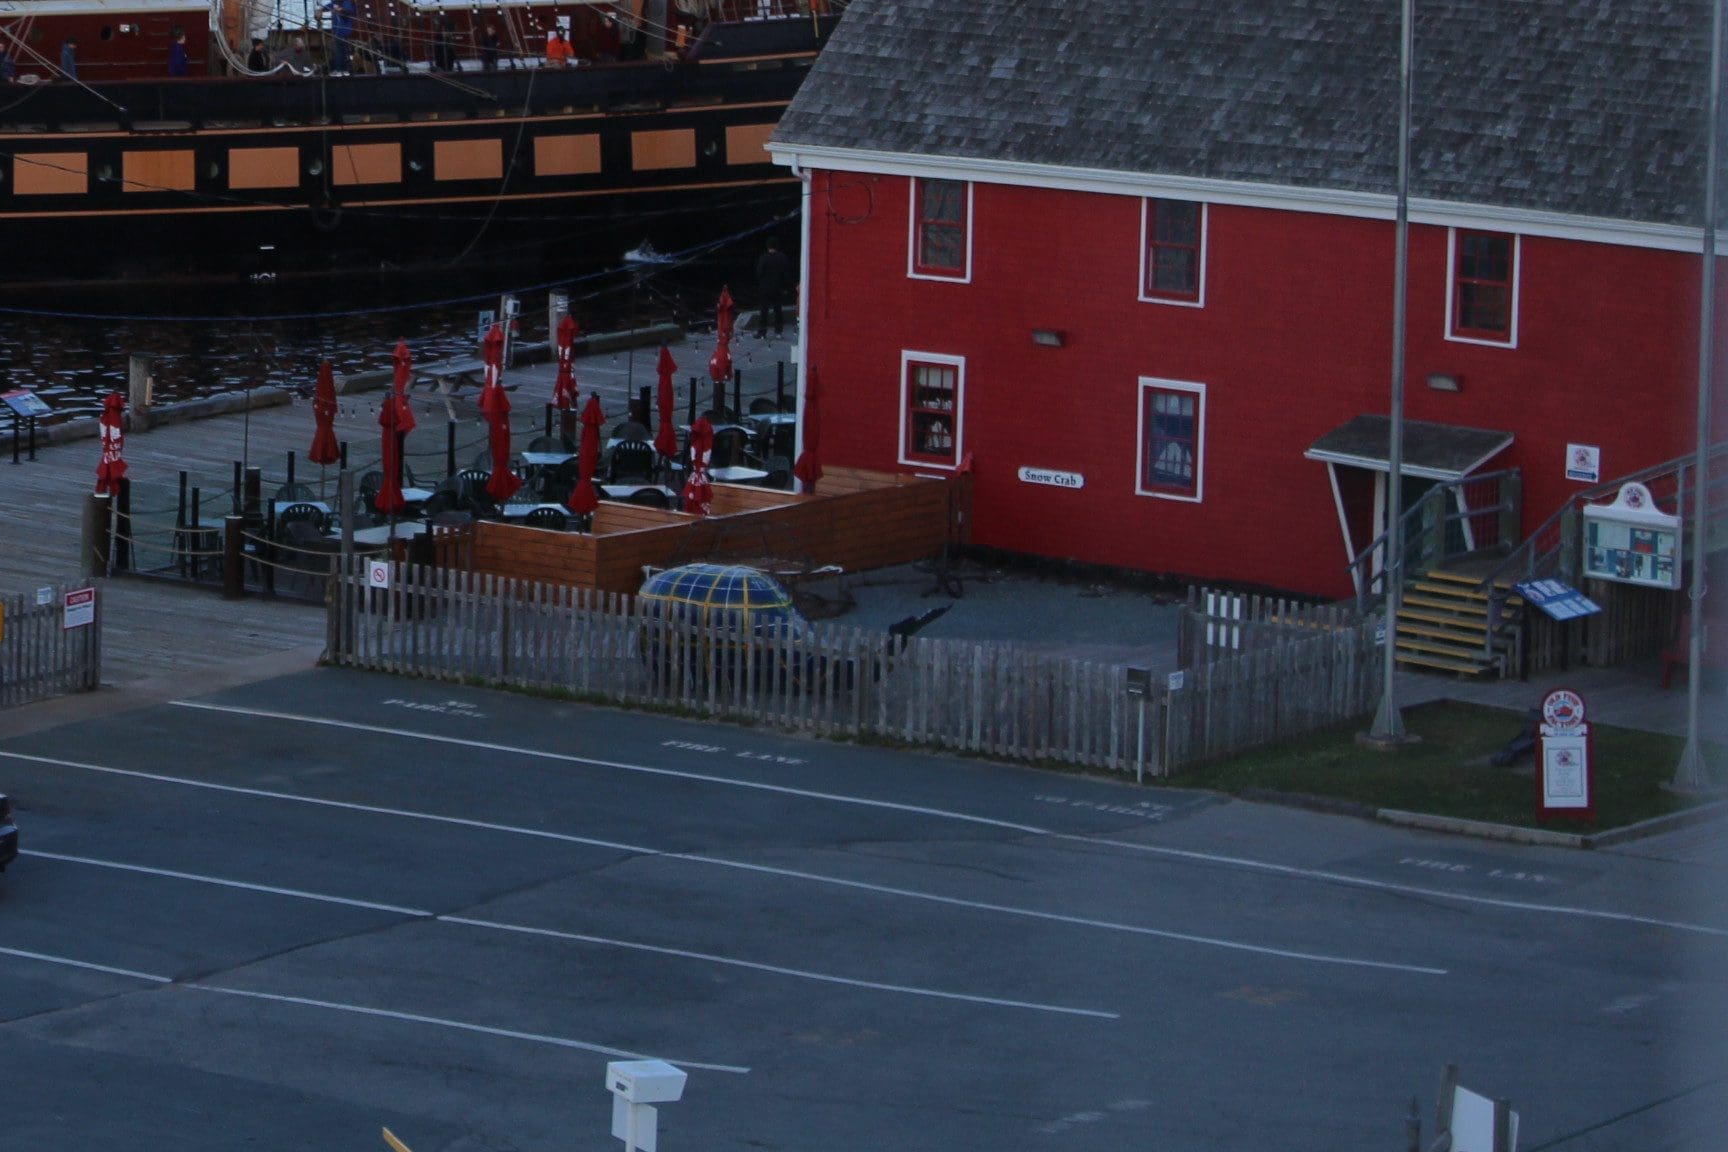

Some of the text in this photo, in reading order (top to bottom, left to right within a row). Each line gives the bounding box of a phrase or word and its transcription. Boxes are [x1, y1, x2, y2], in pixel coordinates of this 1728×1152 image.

[1025, 470, 1077, 487] Snow Crab
[661, 740, 809, 765] FIRE LANE
